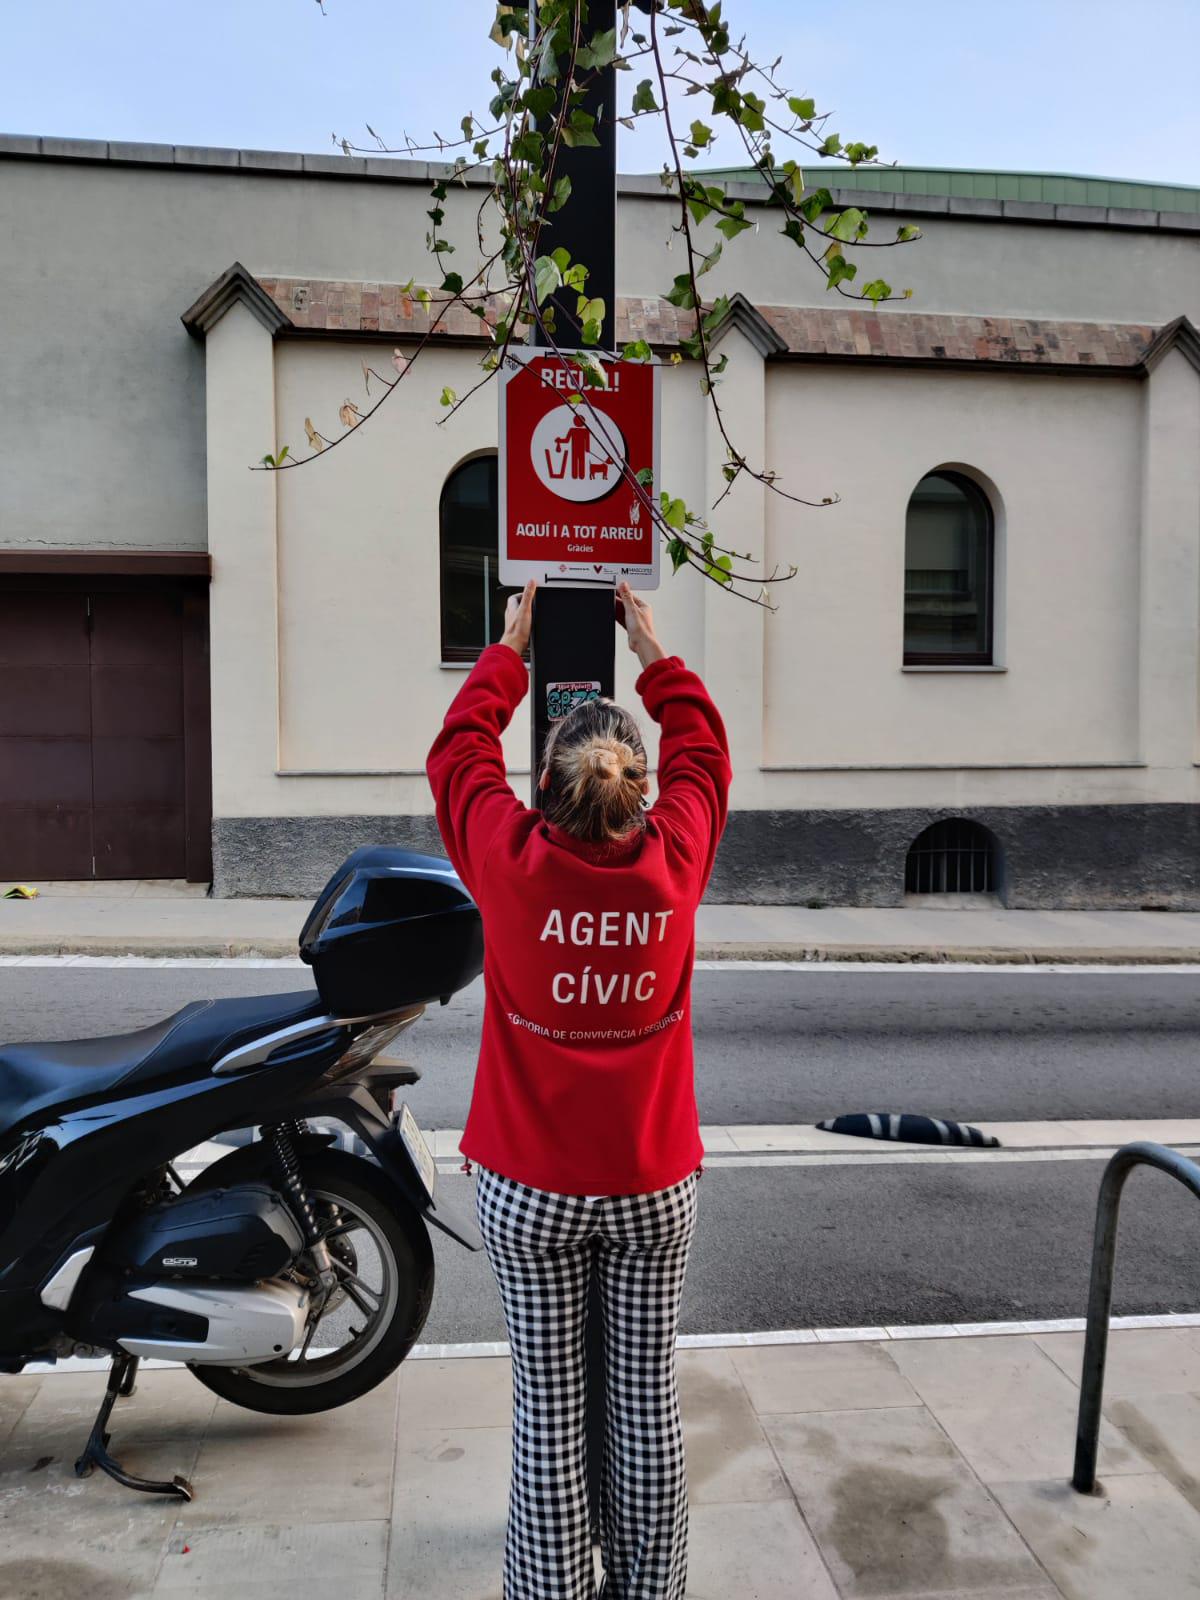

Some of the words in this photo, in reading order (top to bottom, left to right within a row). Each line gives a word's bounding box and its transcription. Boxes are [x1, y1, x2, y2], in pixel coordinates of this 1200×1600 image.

[516, 521, 551, 537] AQUÍ
[553, 524, 558, 537] I
[561, 526, 571, 538] A
[573, 525, 597, 539] TOT
[600, 526, 644, 541] ARREU
[567, 543, 594, 553] Gràcies
[539, 909, 674, 946] AGENT
[552, 966, 656, 1004] CÍVIC
[552, 1029, 567, 1040] DE
[569, 1028, 636, 1040] CONVIVÈNCIA
